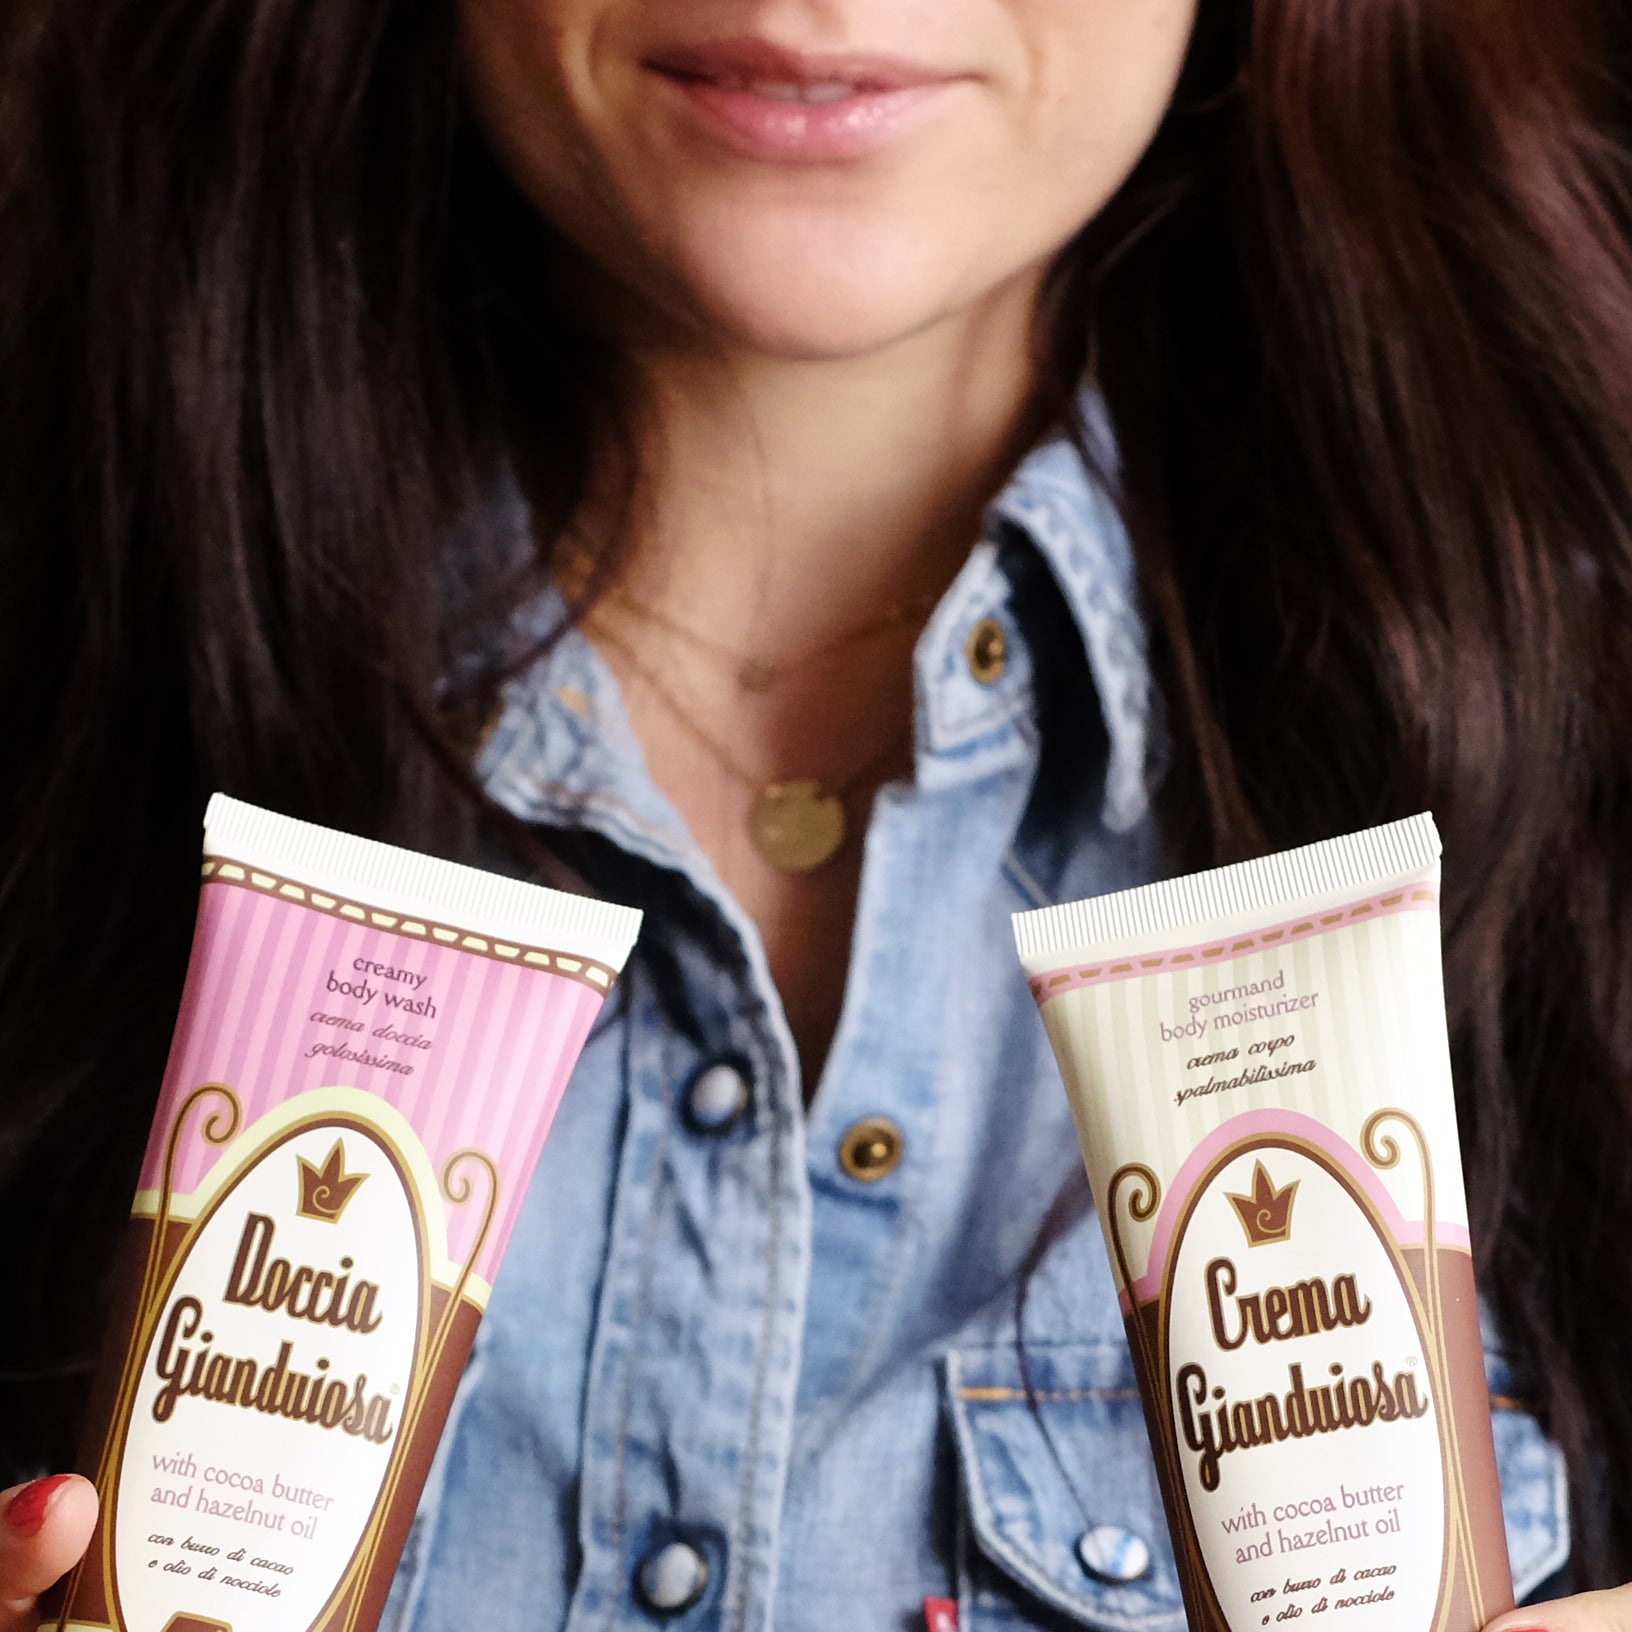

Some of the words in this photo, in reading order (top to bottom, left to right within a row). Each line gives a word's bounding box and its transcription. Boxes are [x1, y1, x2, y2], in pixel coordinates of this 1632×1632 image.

[326, 970, 378, 1005] body
[384, 996, 437, 1019] wash
[353, 957, 427, 991] creamy
[1189, 969, 1284, 1014] gourmand
[310, 1012, 365, 1032] crema
[372, 1024, 432, 1050] doccia
[1160, 1015, 1207, 1042] body
[1214, 993, 1319, 1030] moisturizer
[304, 1042, 414, 1076] golosissima
[1186, 1046, 1239, 1071] crema
[1248, 1034, 1295, 1057] corpo
[1173, 1059, 1317, 1107] spalmabilissima
[223, 1210, 383, 1334] Doccia
[1204, 1256, 1373, 1352] Crema
[152, 1295, 393, 1445] Gianduiosa
[1175, 1360, 1429, 1493] Gianduiosa
[152, 1451, 197, 1478] with
[203, 1465, 264, 1495] cocoa
[271, 1473, 335, 1513] butter
[150, 1484, 189, 1509] and
[195, 1489, 285, 1532] hazelnut
[290, 1515, 318, 1541] oil
[1221, 1502, 1267, 1535] with
[1273, 1496, 1337, 1523] cocoa
[1340, 1484, 1405, 1509] butter
[147, 1533, 175, 1546] con
[226, 1548, 247, 1562] di
[250, 1557, 294, 1575] cacao
[1235, 1532, 1273, 1564] and
[1278, 1519, 1369, 1553] hazelnut
[1375, 1508, 1401, 1535] oil
[148, 1559, 158, 1568] e
[163, 1559, 191, 1575] olio
[197, 1566, 218, 1581] di
[219, 1576, 282, 1598] nocciole
[1250, 1588, 1276, 1603] con
[1329, 1568, 1347, 1585] di
[1353, 1564, 1397, 1581] cacao
[1276, 1603, 1303, 1622] olio
[1311, 1596, 1328, 1614] di
[1334, 1585, 1395, 1610] nocciole
